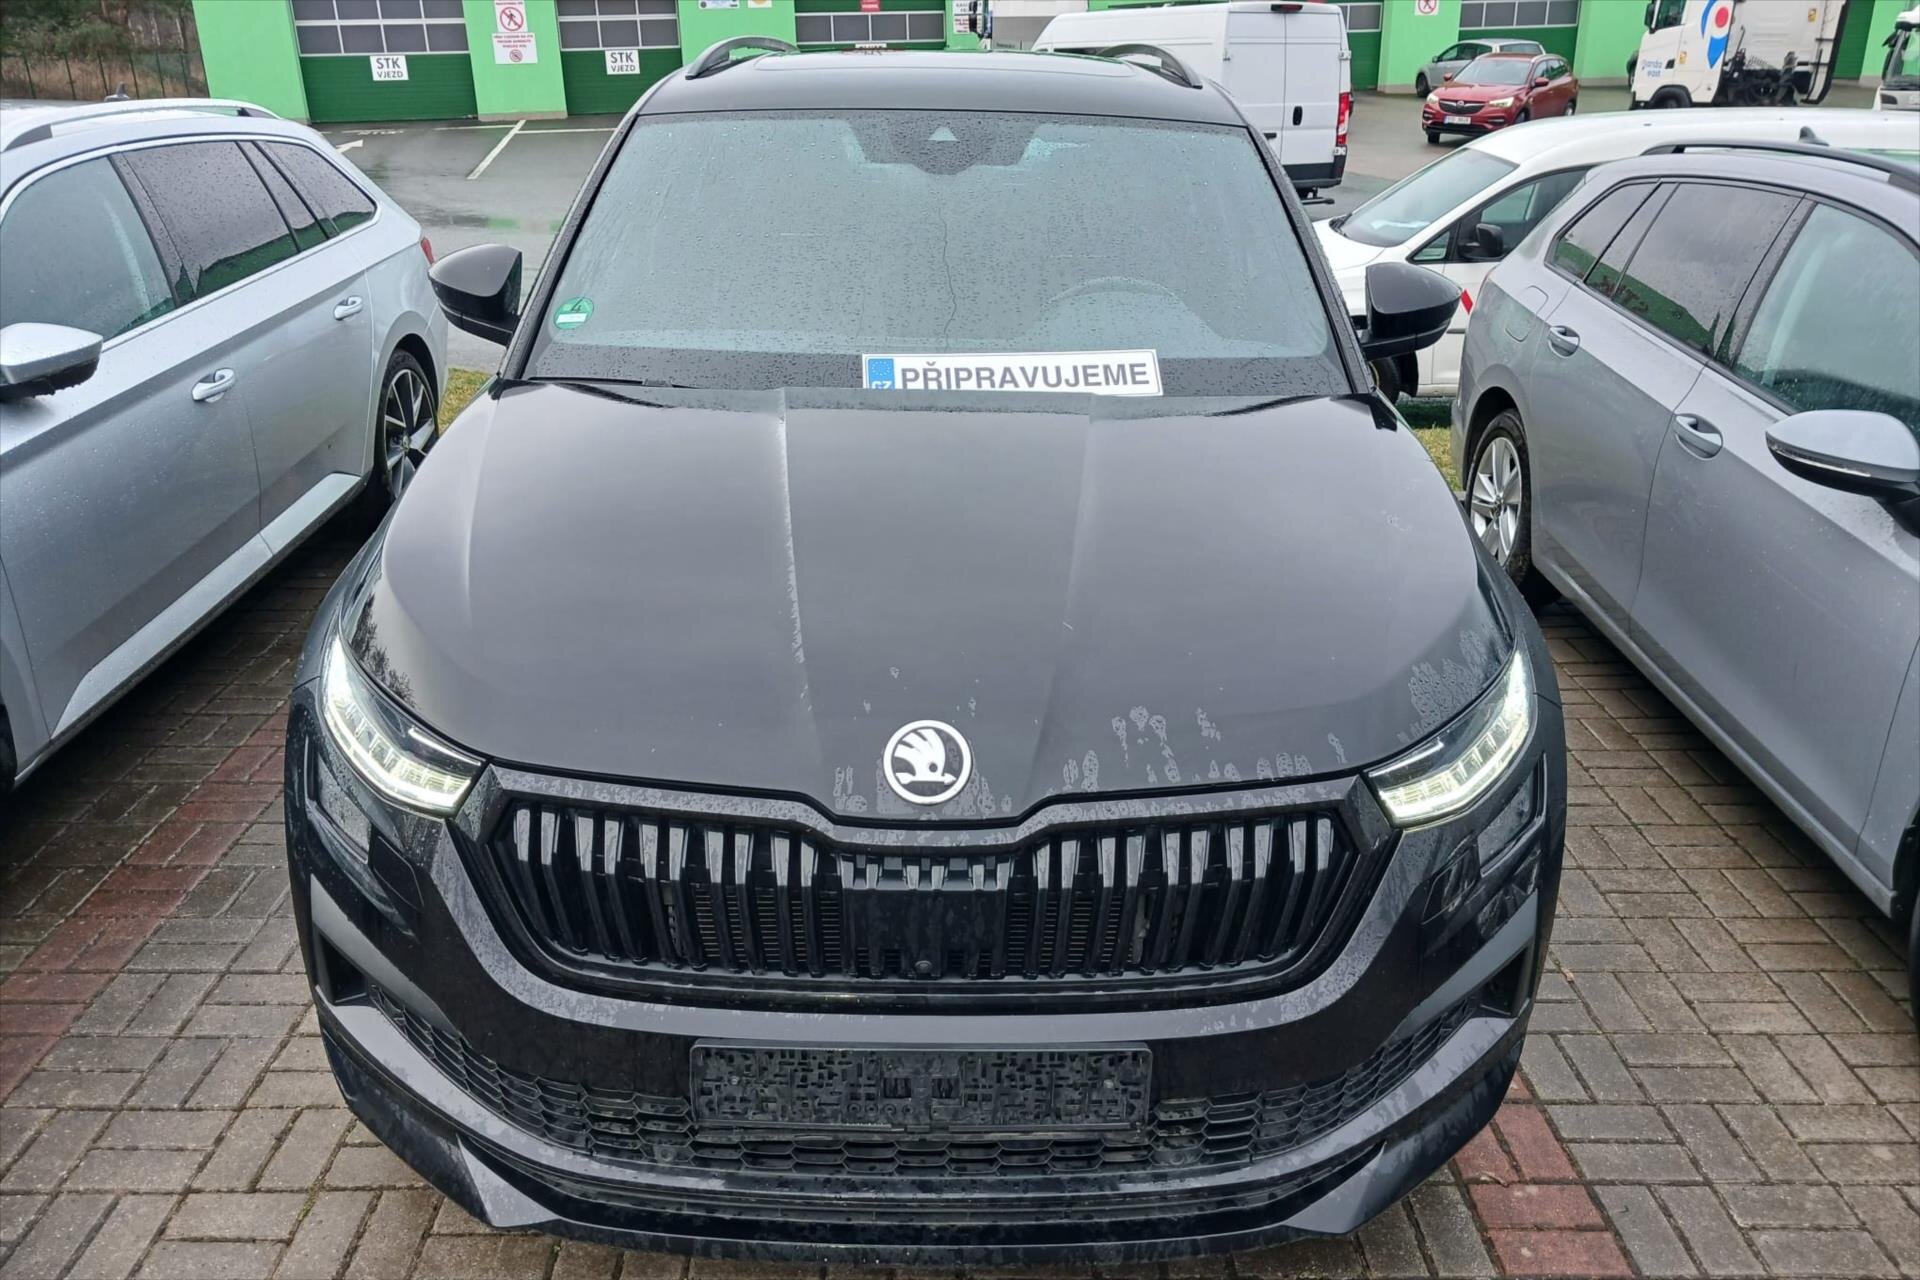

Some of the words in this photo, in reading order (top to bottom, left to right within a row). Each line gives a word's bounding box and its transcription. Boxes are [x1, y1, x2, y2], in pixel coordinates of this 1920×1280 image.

[375, 57, 401, 69] STK
[611, 52, 633, 63] STK
[901, 361, 1150, 389] PŘIPRAVUJEME
